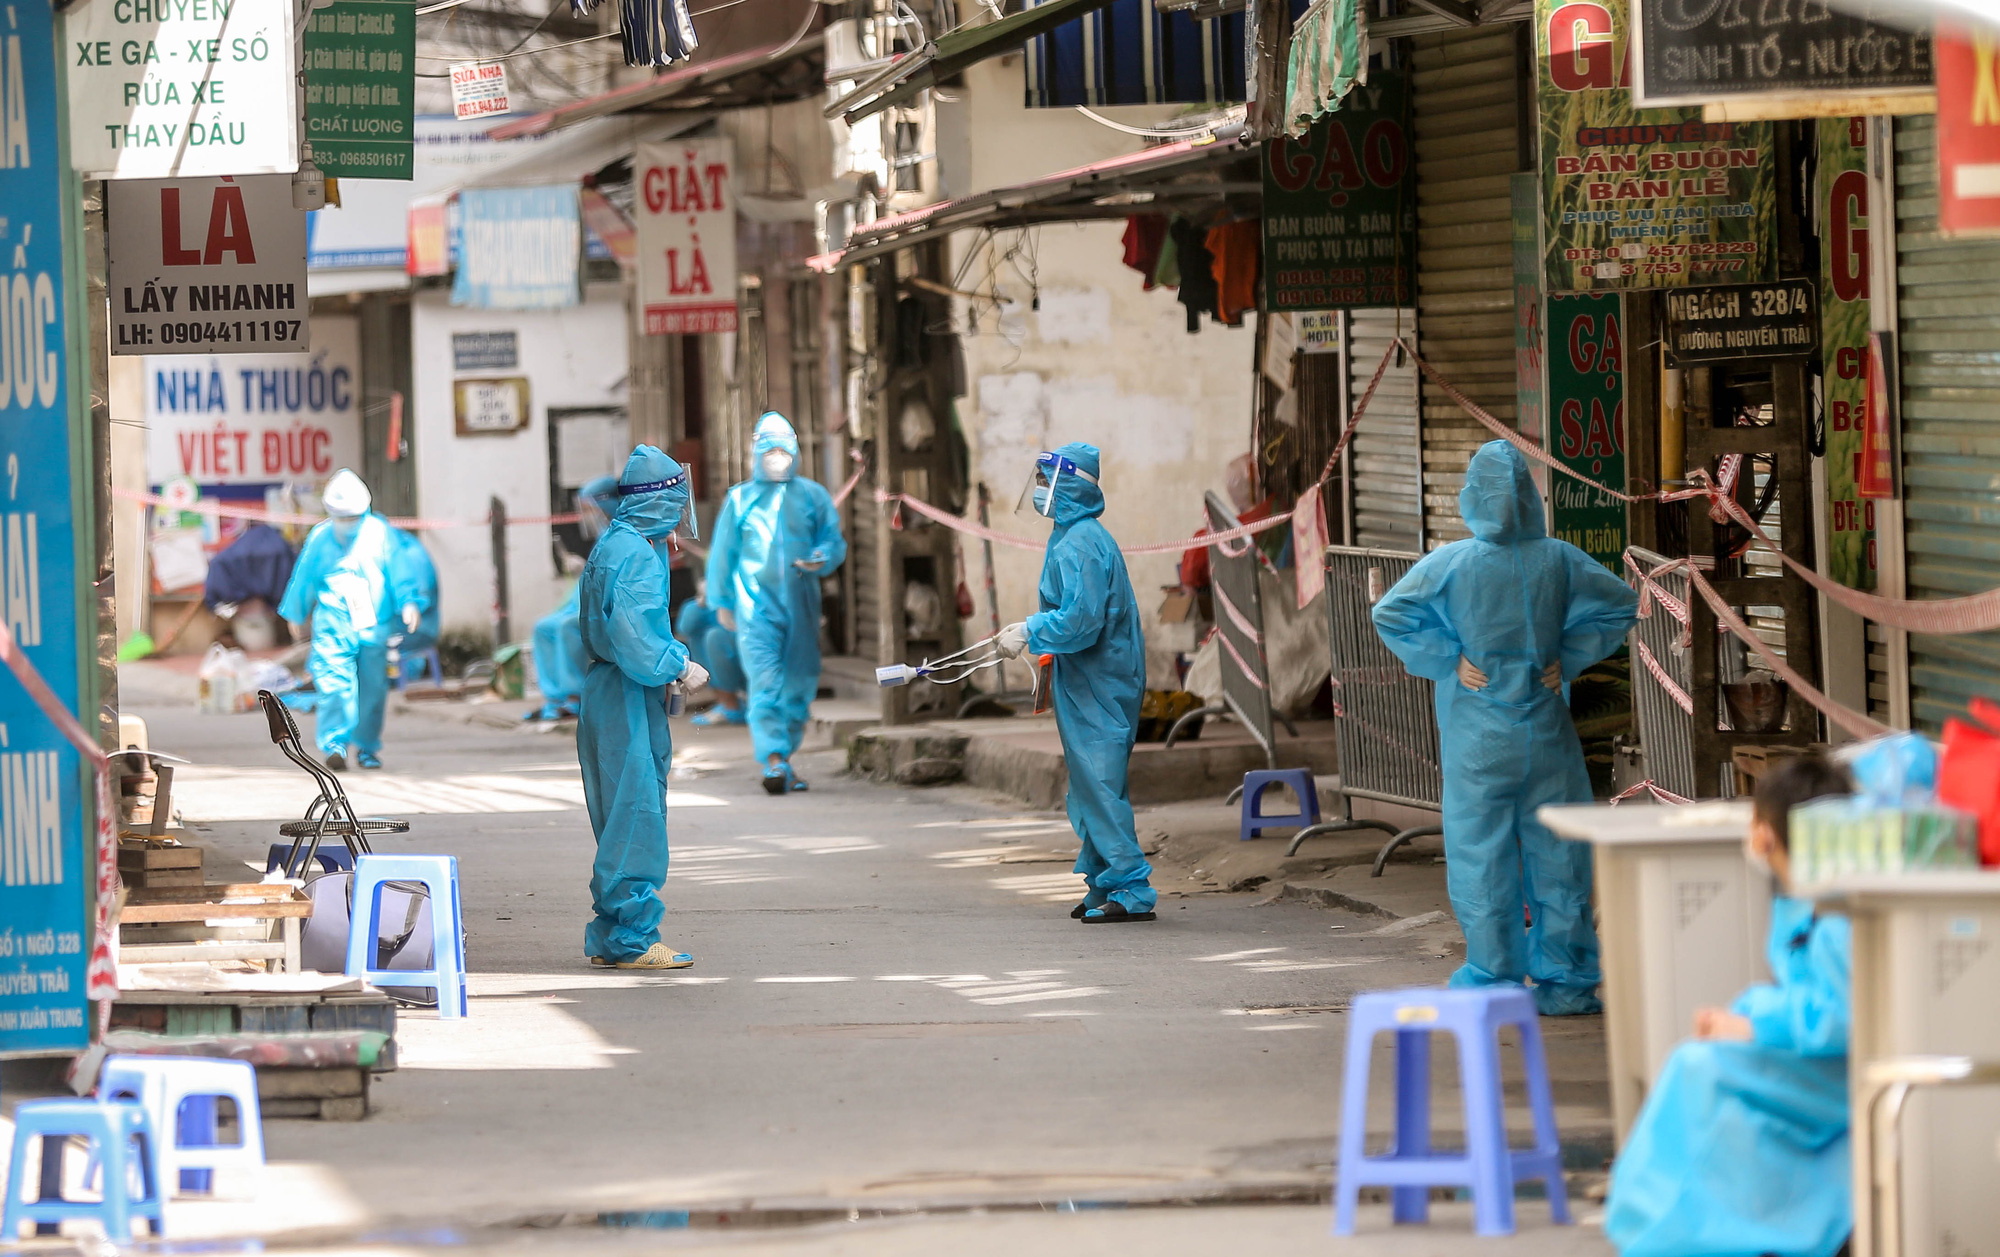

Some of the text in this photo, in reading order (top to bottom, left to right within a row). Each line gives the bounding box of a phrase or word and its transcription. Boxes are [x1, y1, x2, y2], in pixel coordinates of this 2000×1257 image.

[76, 41, 112, 66] XE
[121, 40, 160, 65] GA
[187, 39, 222, 63] XE
[232, 27, 269, 62] SỐ
[1663, 44, 1733, 82] SINH
[1740, 32, 1783, 78] TỐ
[1807, 28, 1902, 76] NƯỚC
[0, 5, 30, 169] À
[454, 66, 477, 84] SỬA
[124, 73, 225, 107] RỬA XE
[105, 112, 245, 149] THAY DẦU
[309, 114, 404, 136] CHẤT LƯỢNG
[1577, 121, 1736, 147] CHUYÊN
[340, 153, 405, 166] 0968501617
[1270, 119, 1408, 207] GẠO
[1556, 147, 1759, 175] BÁN BUÔN
[643, 149, 728, 226] GIẶT
[1589, 170, 1729, 201] BÁN LẺ
[161, 176, 256, 266] LÀ
[1268, 213, 1299, 237] BÁN
[1304, 212, 1345, 237] BUÔN
[1360, 210, 1391, 233] BÁN
[1563, 202, 1756, 226] PHỤC VỤ TẬN NHÀ
[1610, 221, 1710, 238] MIỄN PHÍ
[666, 231, 714, 295] LÀ
[1277, 240, 1318, 265] PHỤC
[1322, 239, 1341, 263] VỤ
[1345, 238, 1369, 262] TẠI
[1566, 247, 1601, 261] ĐT:
[1641, 262, 1683, 276] 753
[1690, 259, 1745, 272] 4777
[124, 277, 295, 313] LẤY NHANH
[1670, 287, 1808, 321] NGÁCH 328/4
[118, 320, 301, 345] LH: 0904411197
[1680, 324, 1811, 350] ĐƯỜNG NGUYỄN TRÃI
[156, 350, 350, 414] NHÀ THUỐC
[178, 418, 332, 485] VIỆT ĐỨC
[1555, 480, 1590, 509] Chất
[1585, 521, 1622, 554] BUÔN
[17, 935, 24, 956] 1
[57, 931, 80, 955] 328
[49, 1006, 83, 1029] TRUNG
